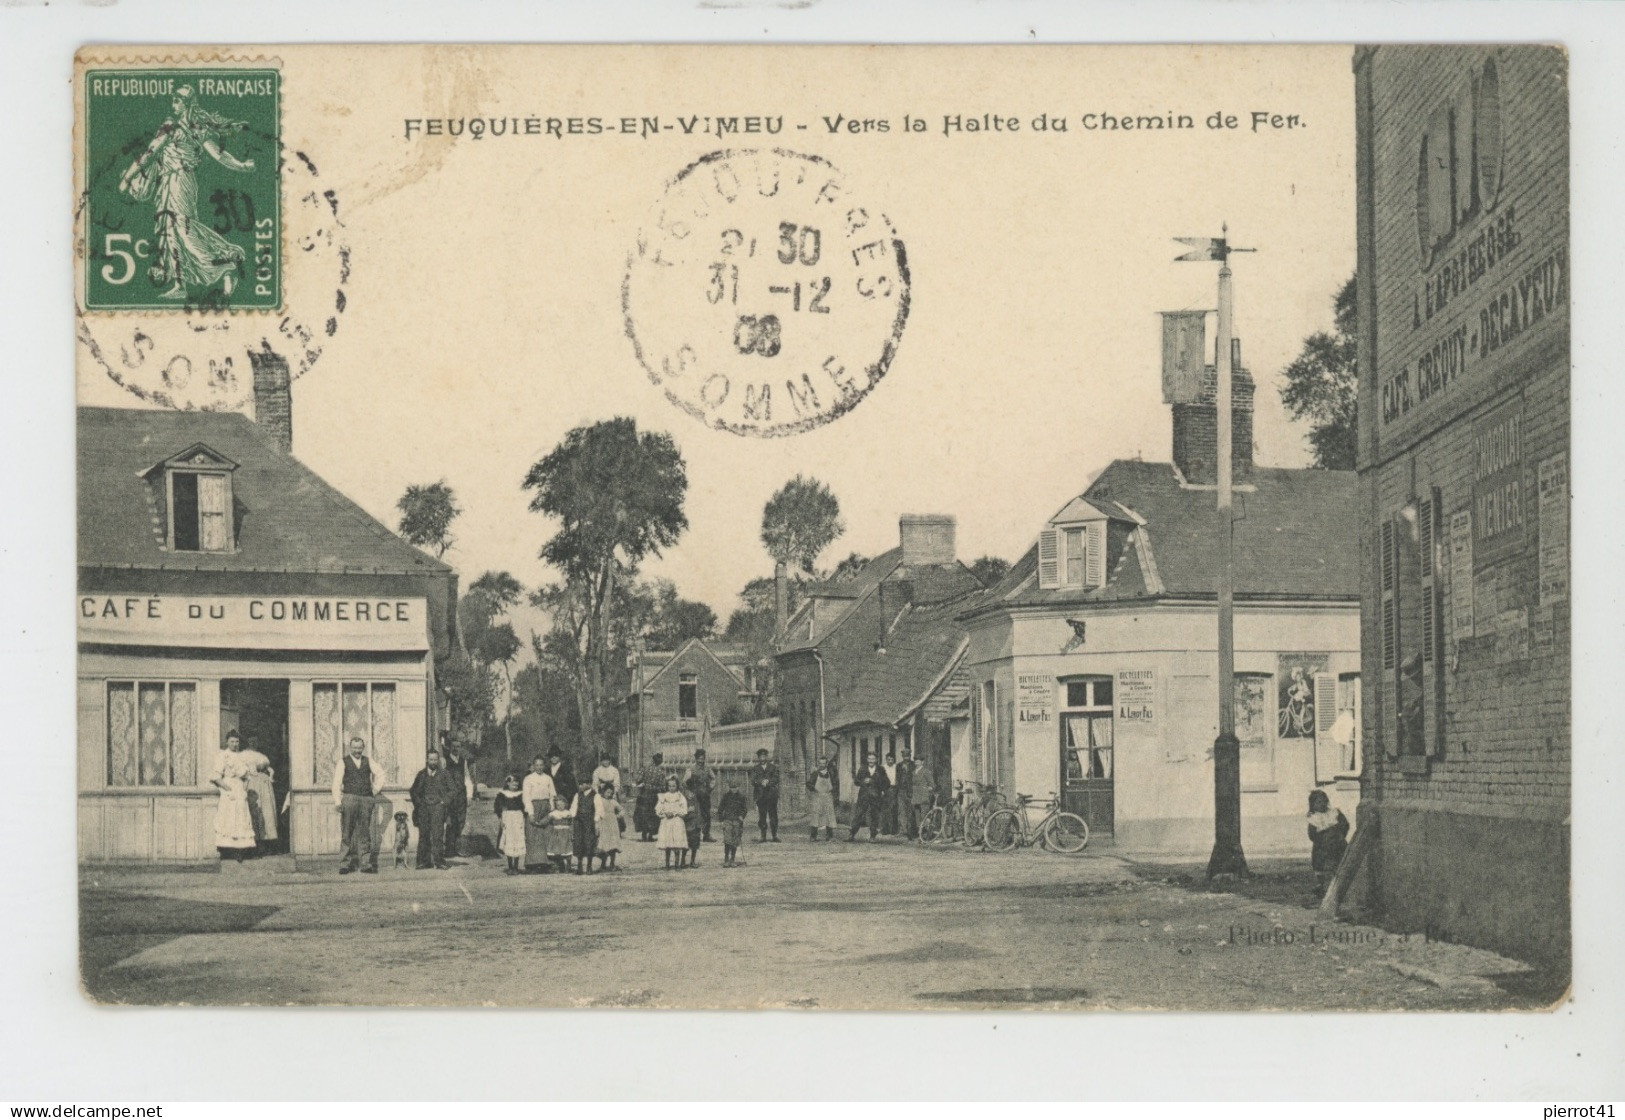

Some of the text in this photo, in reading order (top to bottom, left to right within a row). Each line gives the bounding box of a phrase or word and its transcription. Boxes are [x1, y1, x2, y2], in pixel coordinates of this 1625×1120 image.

[93, 79, 272, 98] REPUBLIQUE FRANÇAISE
[255, 217, 273, 297] POSTES
[777, 221, 822, 266] 30
[662, 343, 859, 421] SOMME
[80, 594, 409, 622] CAFÉ DU COMMERCE
